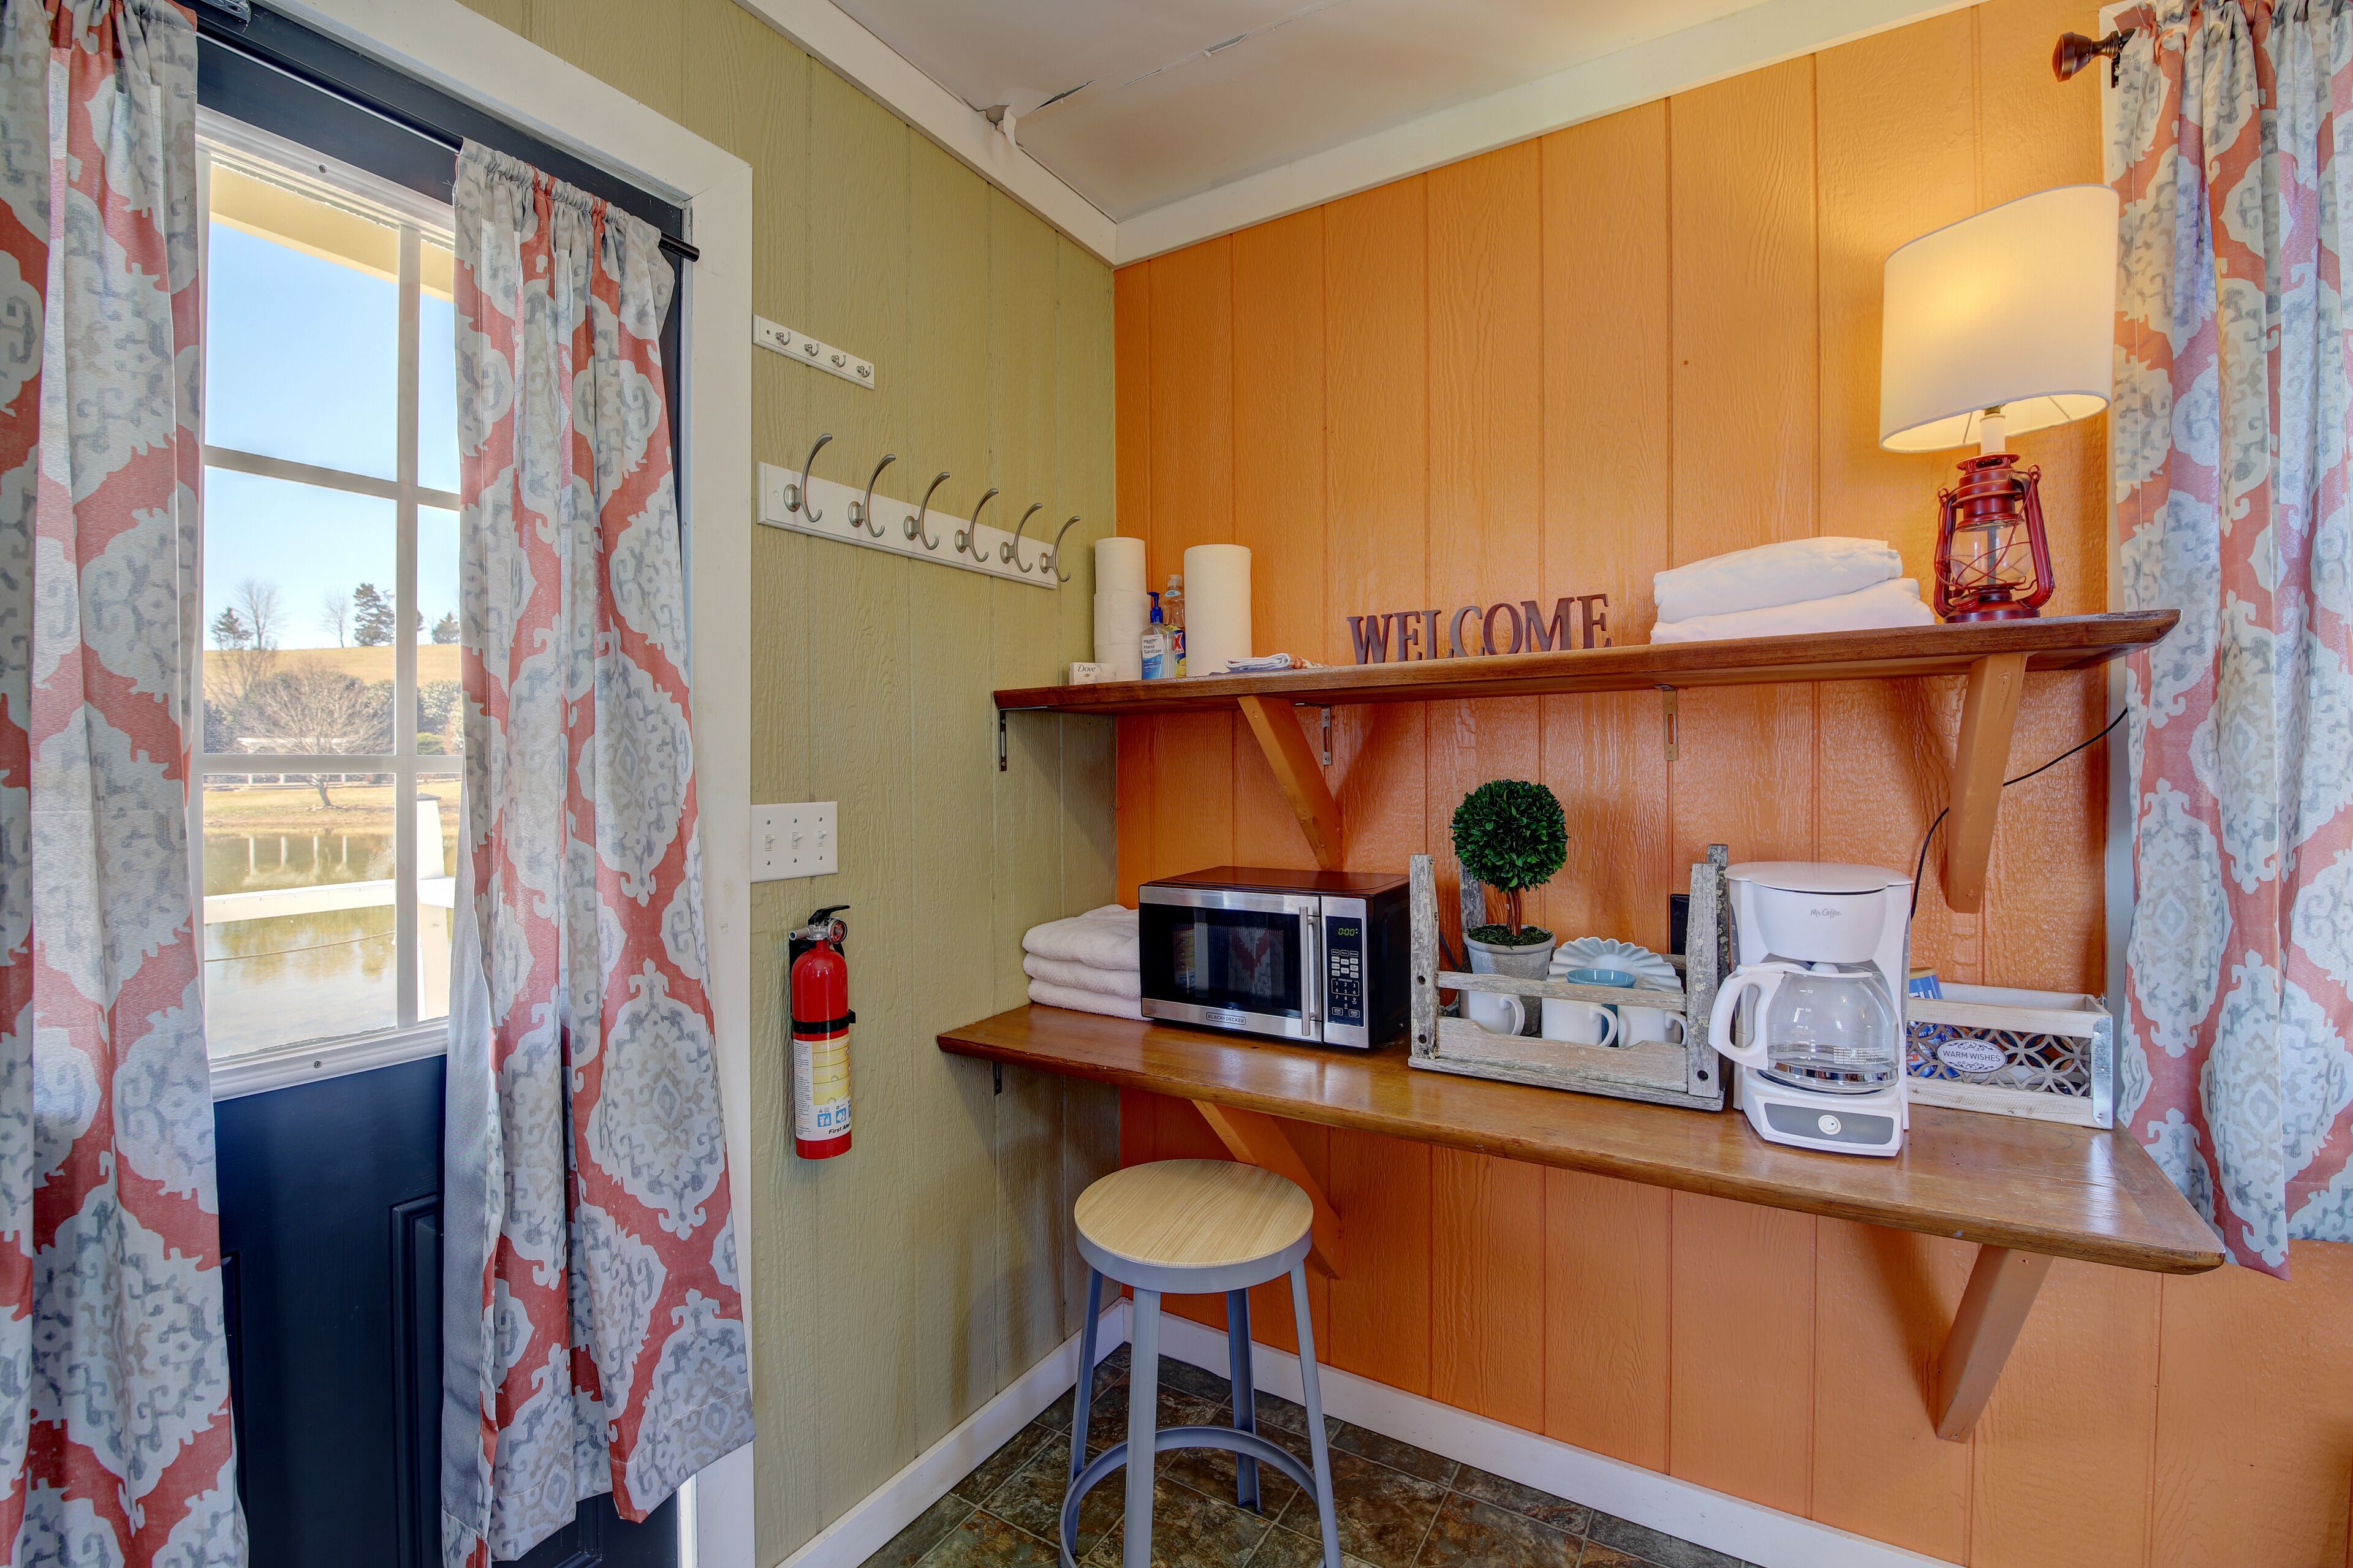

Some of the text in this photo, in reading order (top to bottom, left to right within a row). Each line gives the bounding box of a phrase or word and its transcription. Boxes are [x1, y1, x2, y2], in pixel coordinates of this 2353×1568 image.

[1347, 593, 1612, 665] WELCOME
[1078, 664, 1096, 672] Dove
[1810, 908, 1842, 919] Mr. Coffee
[1338, 928, 1355, 936] 0:00
[1942, 1050, 1968, 1058] WARM
[1969, 1052, 2001, 1062] WISHES
